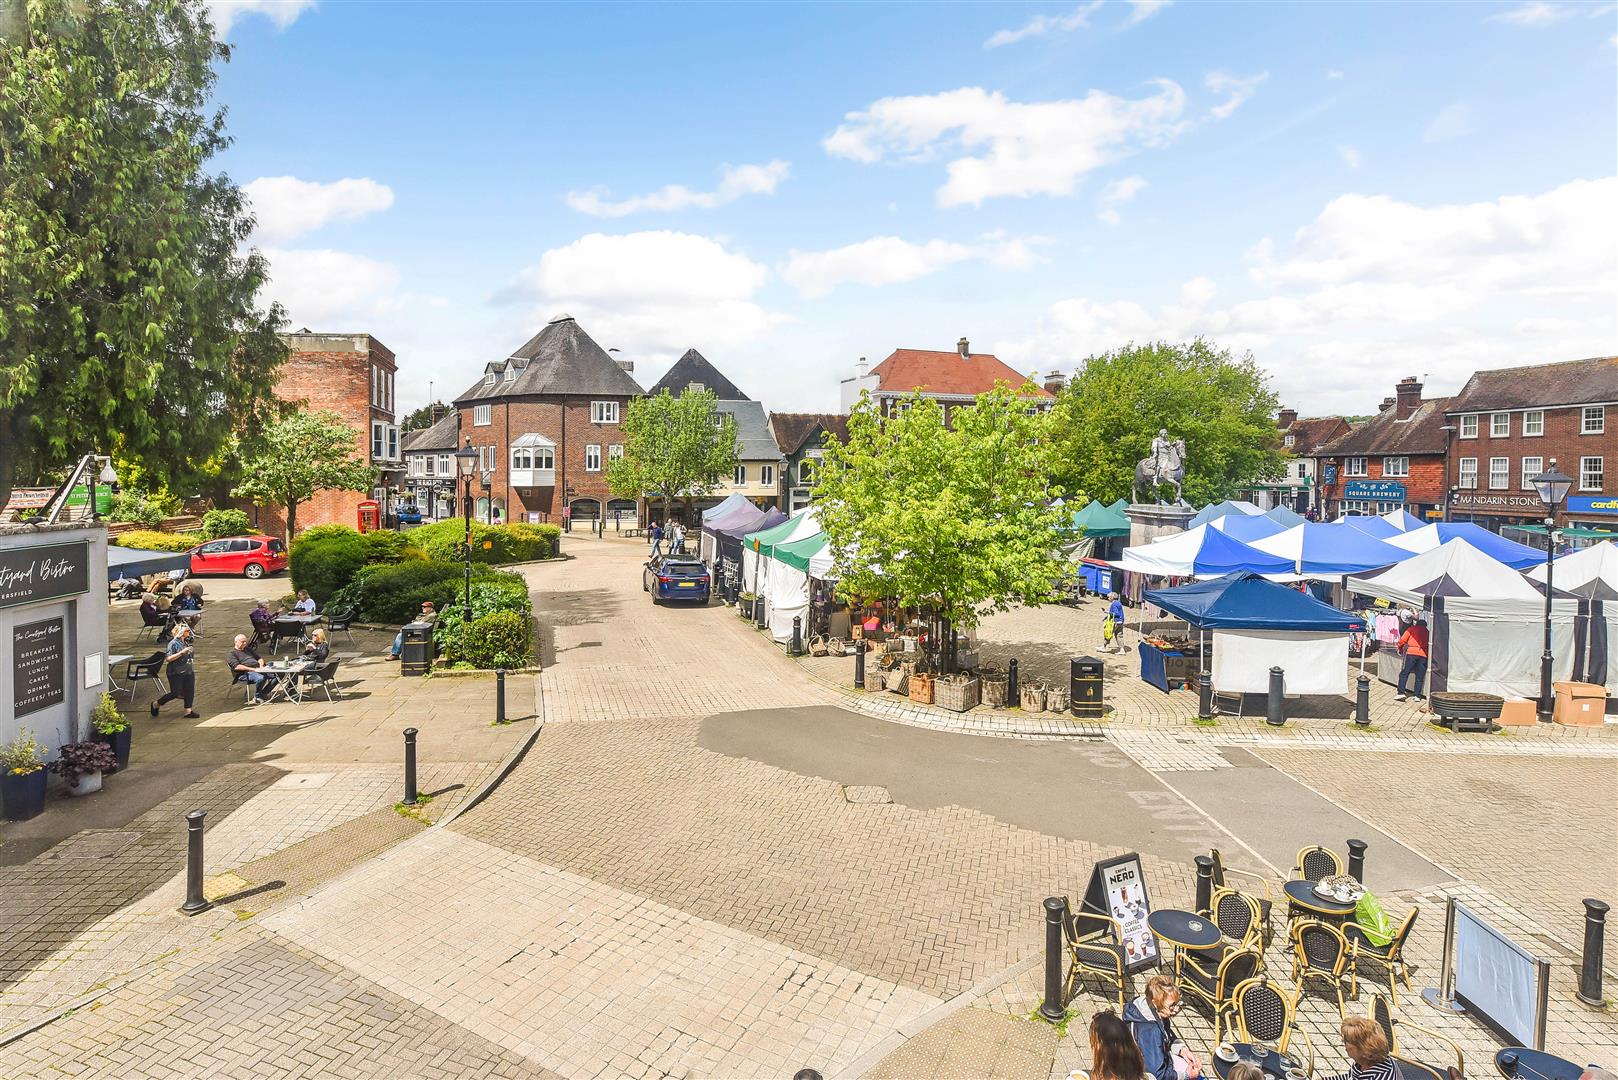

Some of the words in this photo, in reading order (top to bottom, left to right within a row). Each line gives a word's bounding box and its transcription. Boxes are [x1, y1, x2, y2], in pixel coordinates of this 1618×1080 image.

[1460, 496, 1507, 504] MANDARIN
[1509, 497, 1541, 507] STONE
[40, 558, 76, 581] Bistro
[15, 633, 24, 641] The
[21, 645, 55, 658] BREAKFAST
[18, 654, 58, 668] SANDWICHES
[29, 666, 48, 675] LUNCH
[29, 675, 48, 684] CAKES
[28, 683, 50, 694] DRINKS
[15, 693, 46, 707] COFFEES/
[1109, 870, 1135, 885] NERO
